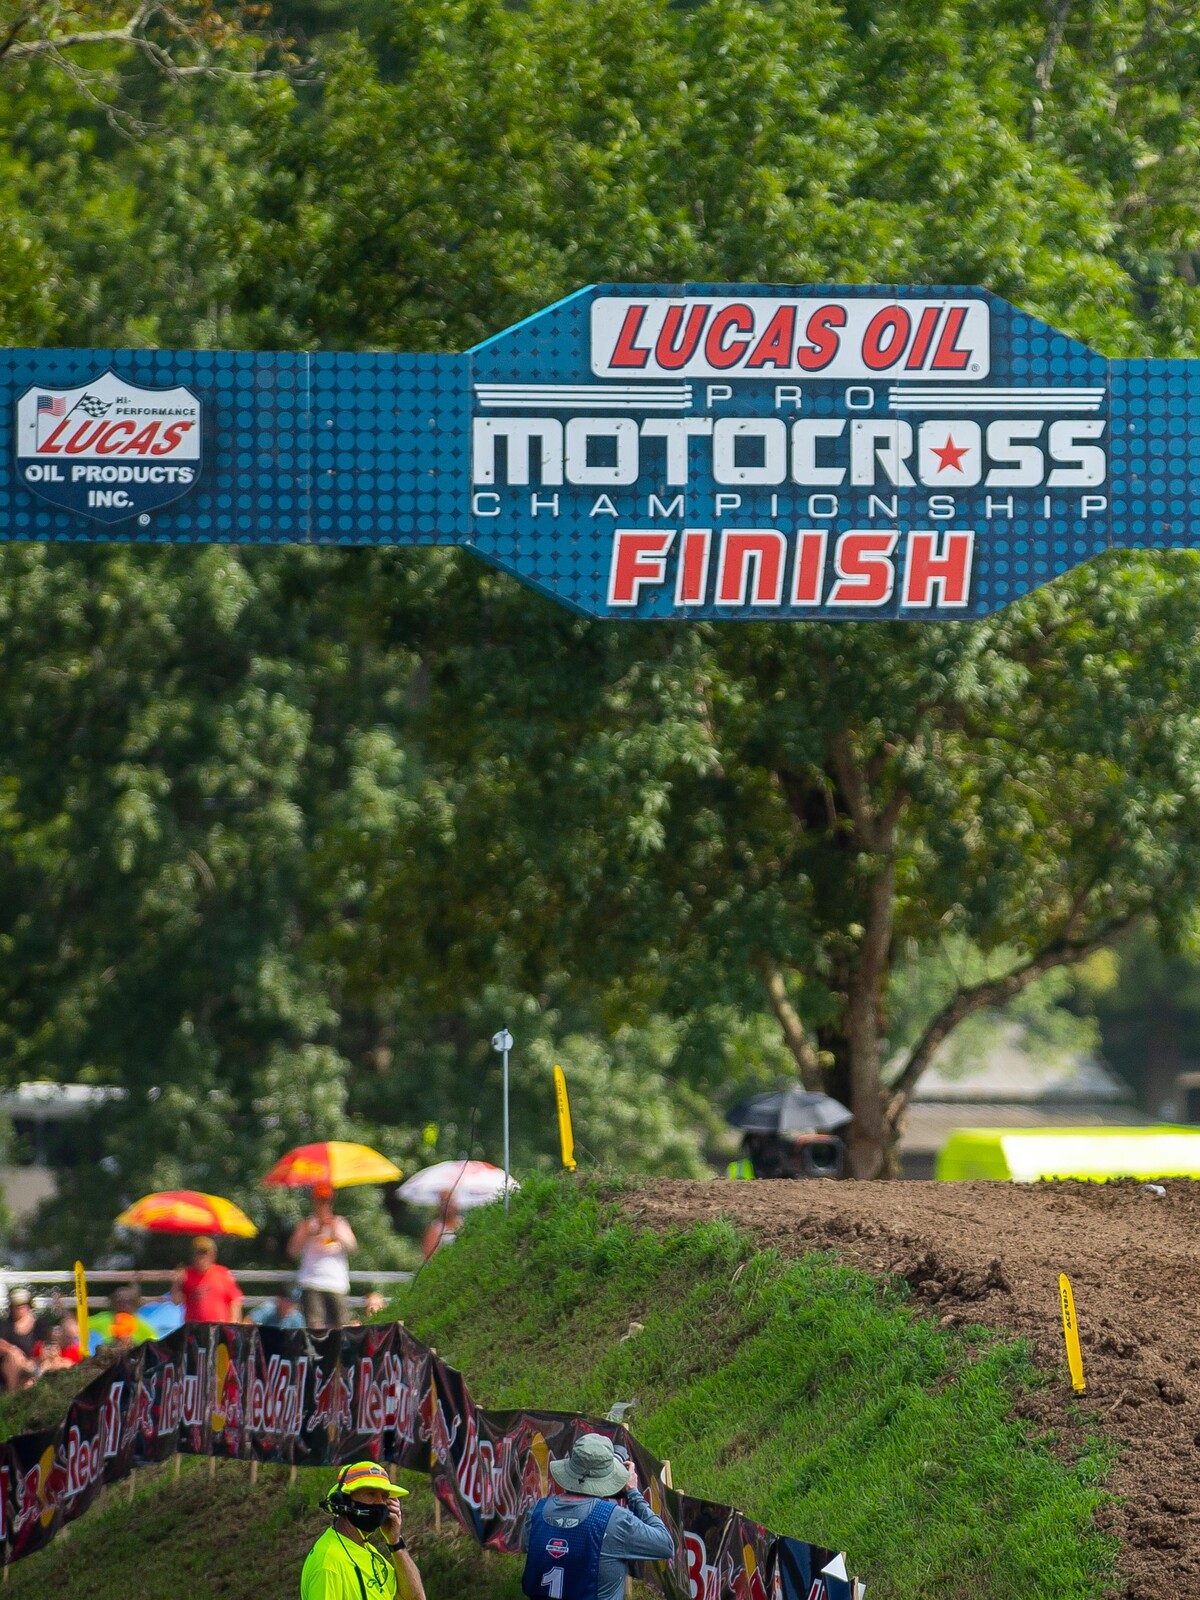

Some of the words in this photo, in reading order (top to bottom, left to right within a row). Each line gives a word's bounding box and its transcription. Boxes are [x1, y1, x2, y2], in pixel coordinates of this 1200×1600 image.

[607, 304, 847, 370] LUCAS
[861, 305, 976, 372] OIL
[116, 407, 196, 417] PERFORMANCE
[706, 385, 876, 409] PRO
[37, 419, 193, 456] LUCAS
[472, 416, 1107, 488] MOTOCROSS
[25, 464, 65, 483] OIL
[71, 464, 194, 484] PRODUCTS
[88, 489, 135, 509] INC.
[472, 492, 1108, 520] CHAMPIONSHIP
[606, 528, 976, 608] FINISH
[540, 1566, 565, 1600] 1
